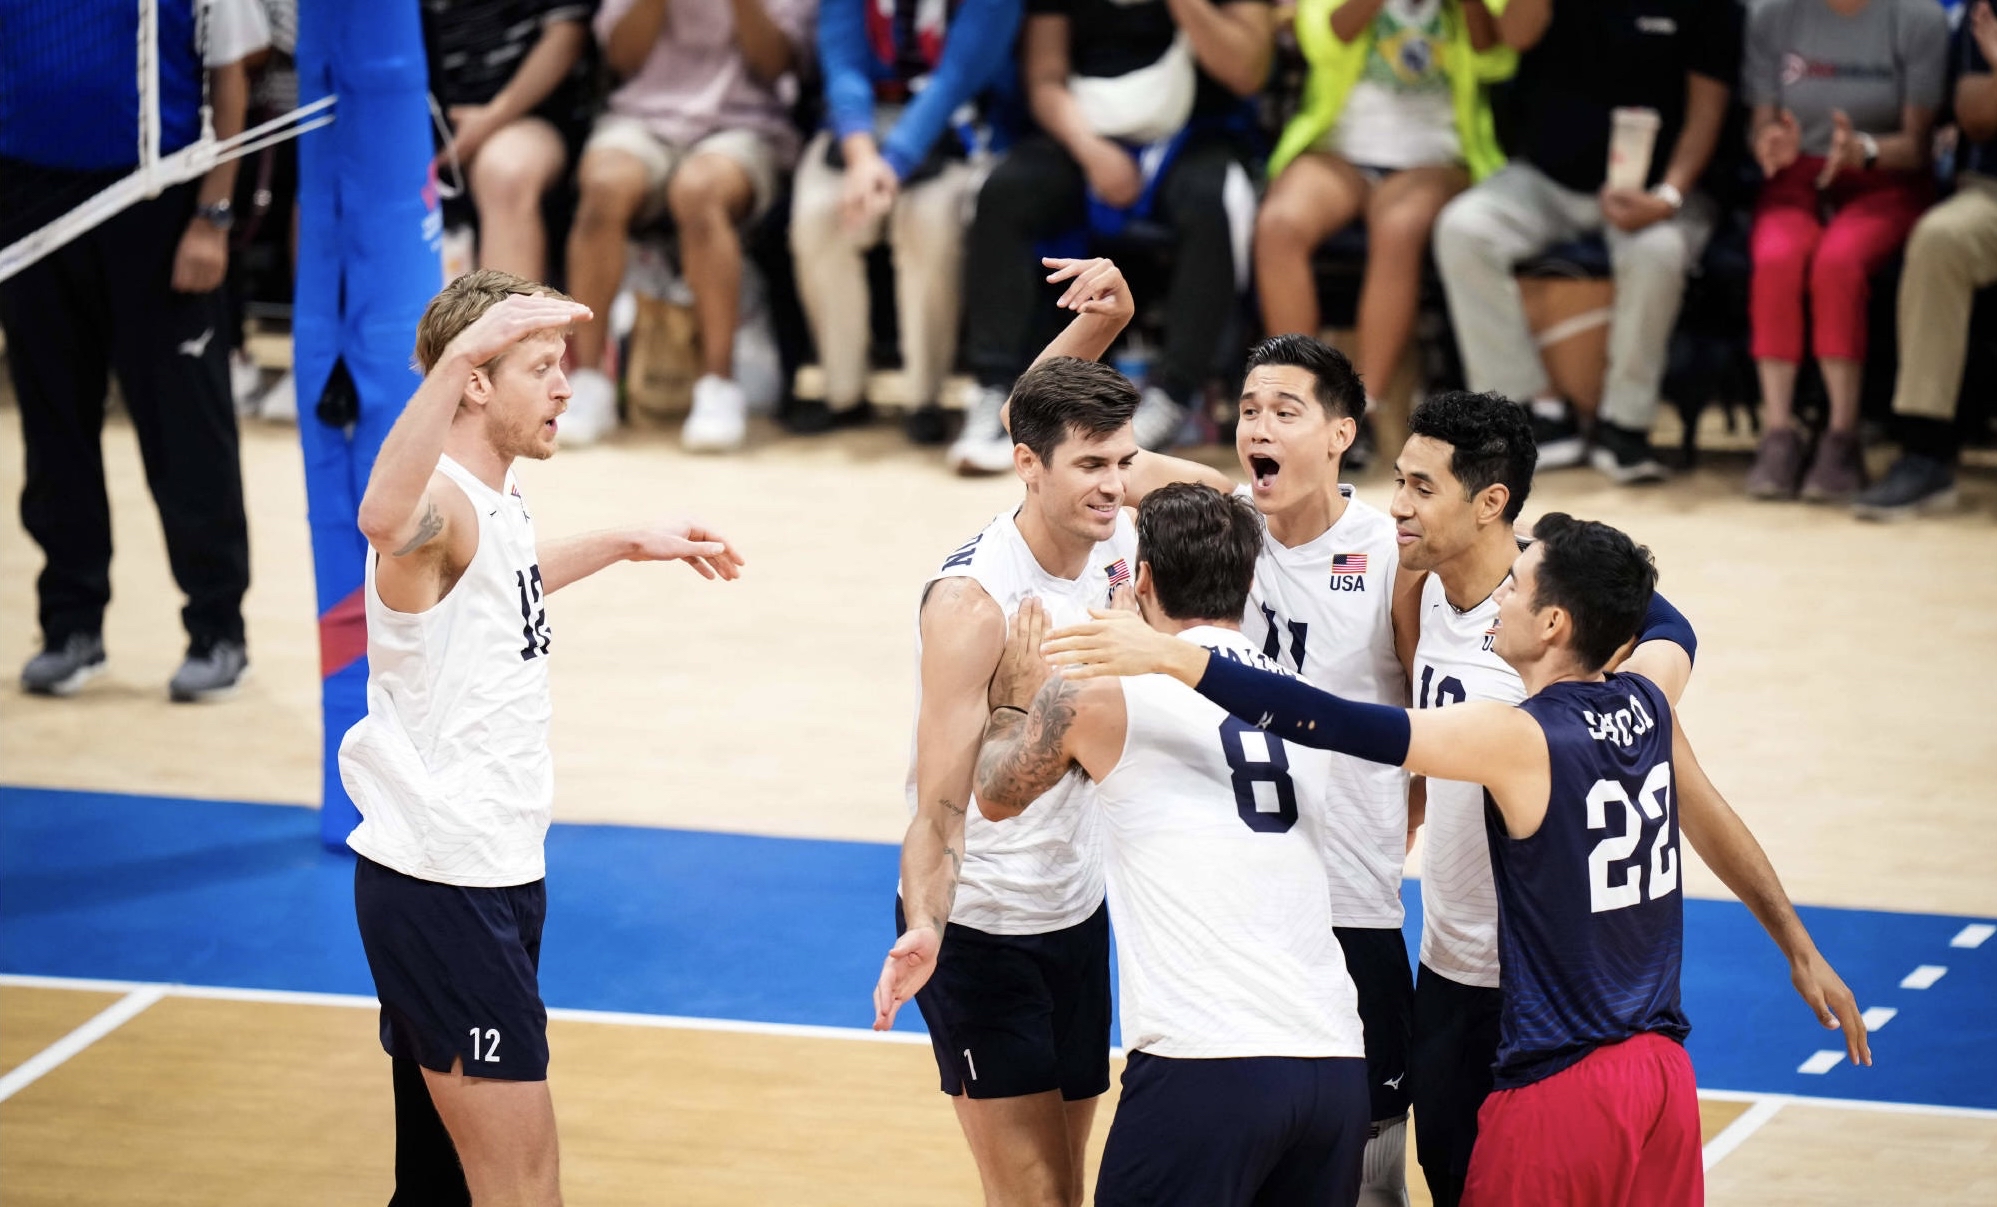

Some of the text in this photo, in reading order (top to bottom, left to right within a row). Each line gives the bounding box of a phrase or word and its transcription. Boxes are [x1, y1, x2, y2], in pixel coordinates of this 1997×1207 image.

[1329, 575, 1366, 592] USA
[1218, 712, 1299, 834] 8
[1585, 760, 1678, 914] 22
[469, 1027, 501, 1062] 12
[963, 1048, 978, 1081] 1
